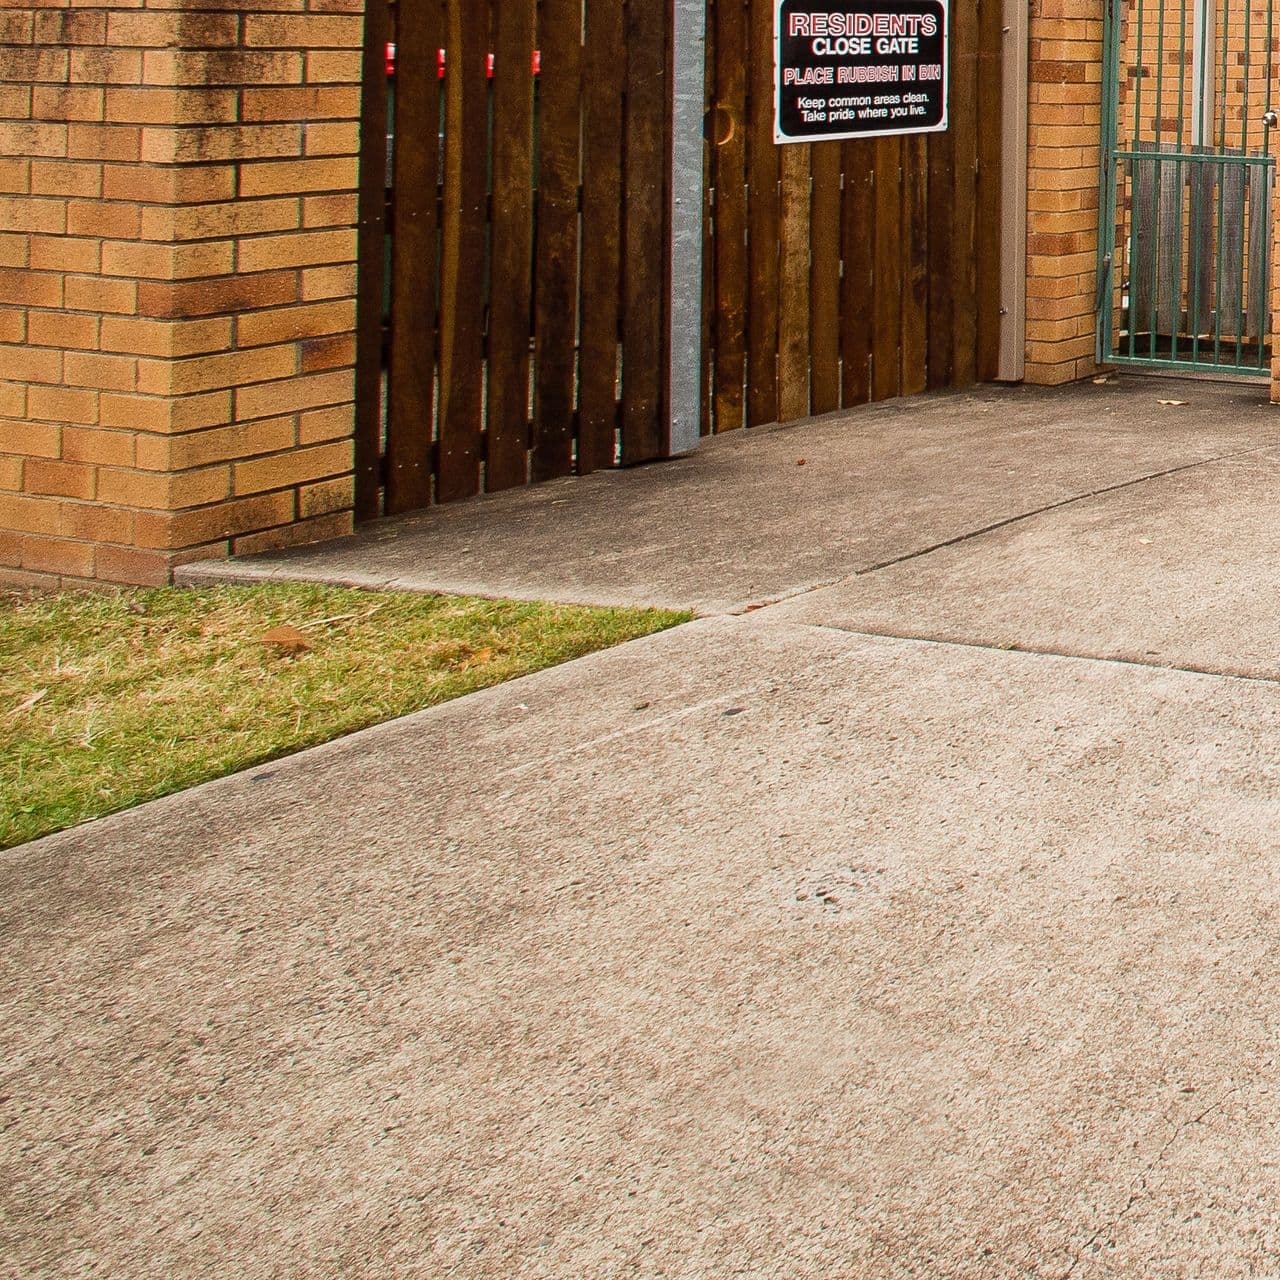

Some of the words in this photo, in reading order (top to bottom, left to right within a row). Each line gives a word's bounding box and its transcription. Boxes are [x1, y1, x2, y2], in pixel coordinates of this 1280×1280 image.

[789, 12, 938, 37] RESIDENTS
[812, 37, 873, 56] CLOSE
[876, 37, 919, 55] GATE
[783, 66, 834, 86] PLACE
[837, 64, 899, 84] RUBBISH
[902, 64, 916, 81] IN
[919, 63, 942, 81] BIN
[798, 96, 826, 110] Keep
[829, 95, 872, 108] common
[874, 94, 901, 105] areas
[903, 92, 930, 104] clean.
[801, 109, 827, 123] Take
[829, 108, 856, 124] pride
[858, 107, 888, 119] where
[890, 107, 908, 119] you
[909, 104, 927, 116] live.
